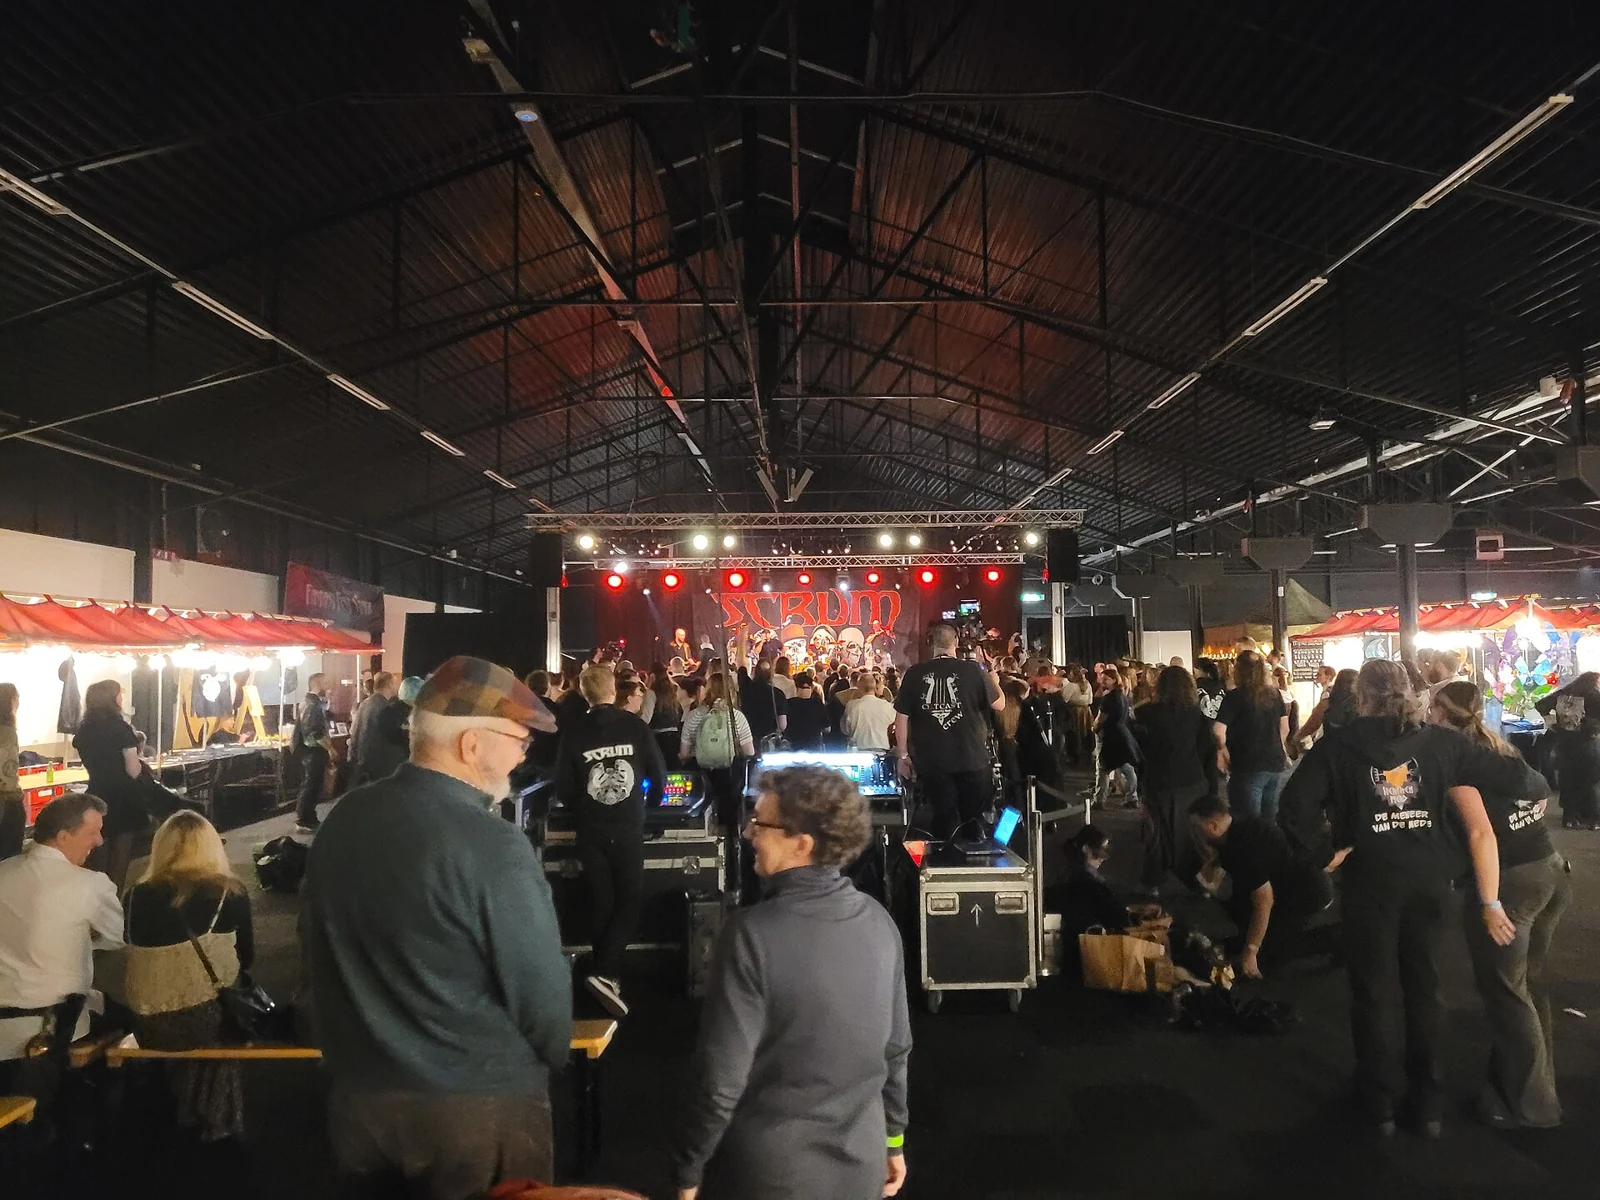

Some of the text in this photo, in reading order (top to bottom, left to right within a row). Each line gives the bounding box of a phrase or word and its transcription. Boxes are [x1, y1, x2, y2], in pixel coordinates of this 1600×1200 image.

[921, 702, 961, 710] OTCAST
[1374, 812, 1388, 822] DE
[1372, 822, 1390, 833] VAN
